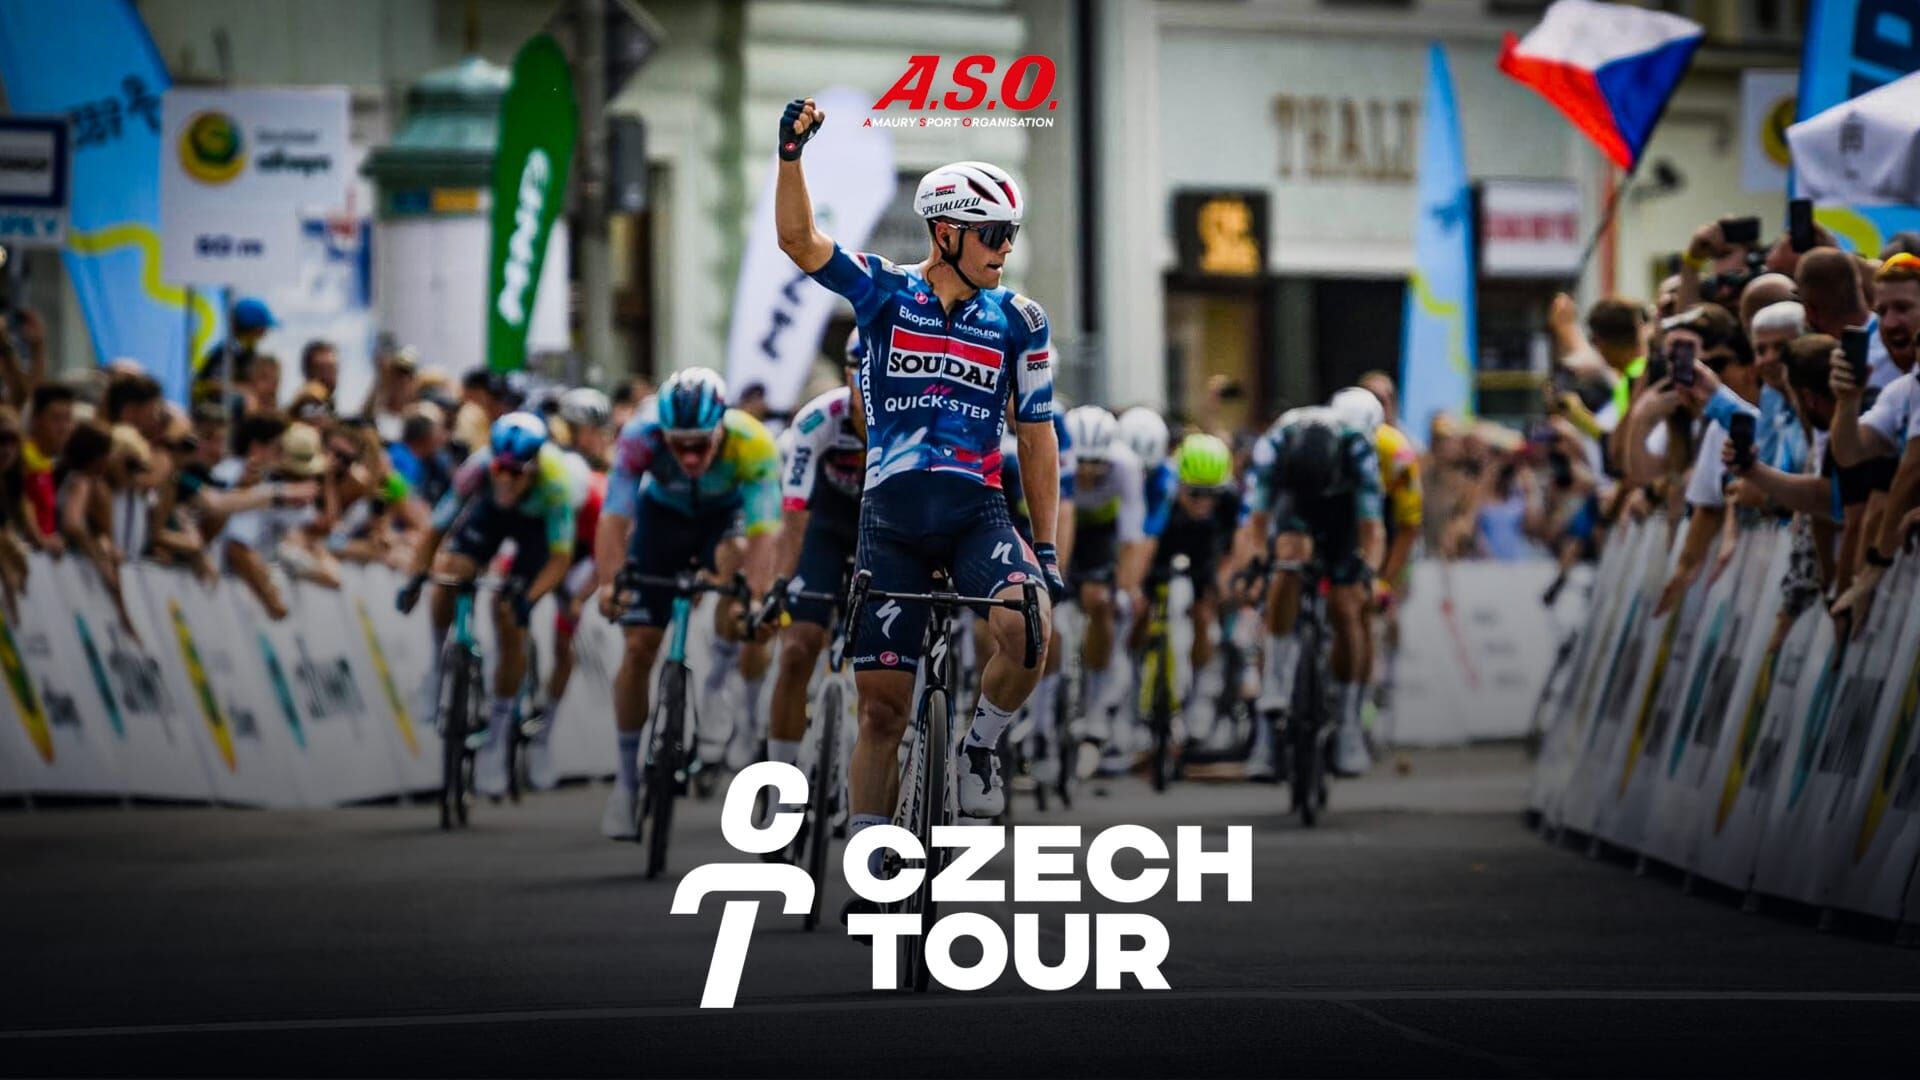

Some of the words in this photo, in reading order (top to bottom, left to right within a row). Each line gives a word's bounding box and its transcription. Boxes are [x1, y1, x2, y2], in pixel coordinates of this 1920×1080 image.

[899, 305, 943, 327] Ekopak
[955, 321, 1000, 339] NAPOLEON
[888, 351, 996, 390] SOUDAL
[861, 349, 876, 426] SOUDAL
